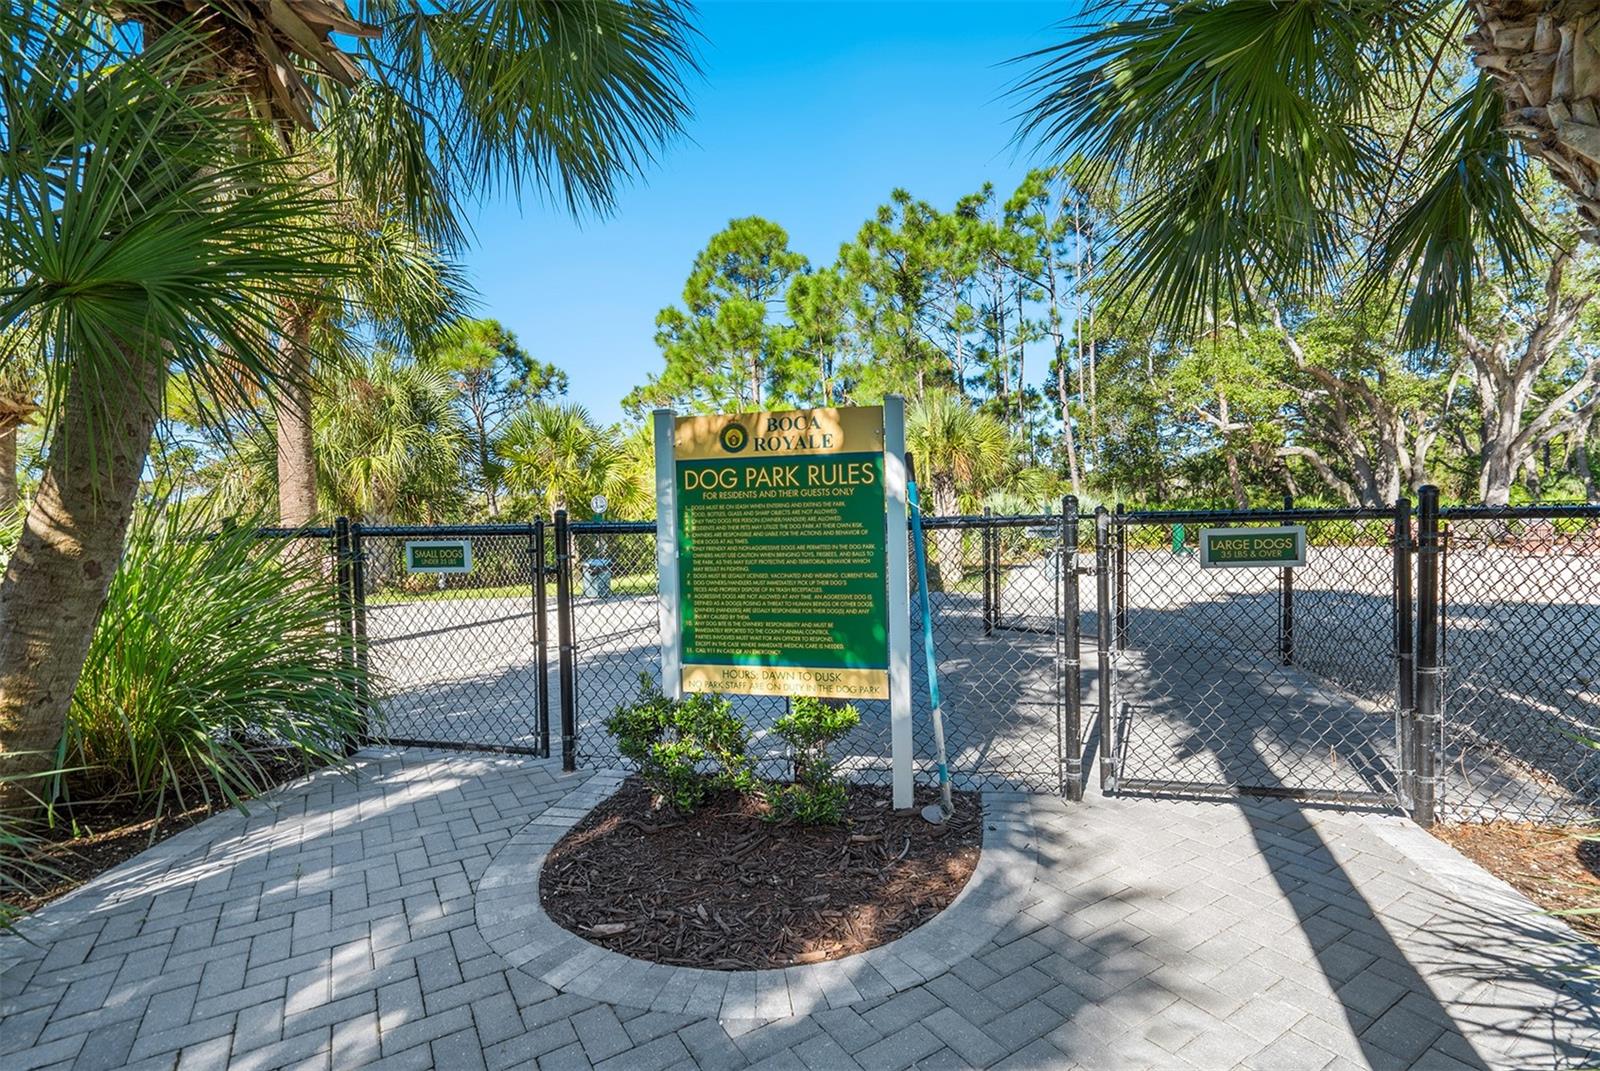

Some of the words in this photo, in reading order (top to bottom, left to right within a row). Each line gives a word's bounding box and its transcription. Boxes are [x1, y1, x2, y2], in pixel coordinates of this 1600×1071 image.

[768, 415, 821, 432] BOCA
[754, 434, 833, 451] ROYALE
[684, 468, 738, 490] DOG
[746, 466, 800, 487] PARK
[808, 463, 875, 486] RULES
[702, 491, 718, 500] FOR
[719, 490, 757, 499] RESIDENTS
[758, 490, 776, 498] AND
[777, 489, 798, 497] THEIR
[801, 488, 830, 497] GUESTS
[833, 487, 854, 496] ONLY
[1211, 539, 1250, 550] LARGE
[1254, 538, 1293, 549] DOGS
[415, 550, 438, 558] SMALL
[440, 550, 463, 558] DOGS
[1259, 550, 1282, 558] OVER
[722, 670, 758, 680] HOURS:
[762, 671, 794, 680] DAWN
[798, 671, 811, 680] TO
[815, 672, 842, 682] DUSK
[726, 681, 747, 689] STAFF
[749, 682, 764, 690] ARE
[768, 682, 781, 690] ON
[784, 683, 804, 691] DUTY
[807, 684, 815, 692] IN
[818, 684, 833, 692] THE
[836, 684, 857, 693] DOG
[860, 686, 880, 694] PARK
